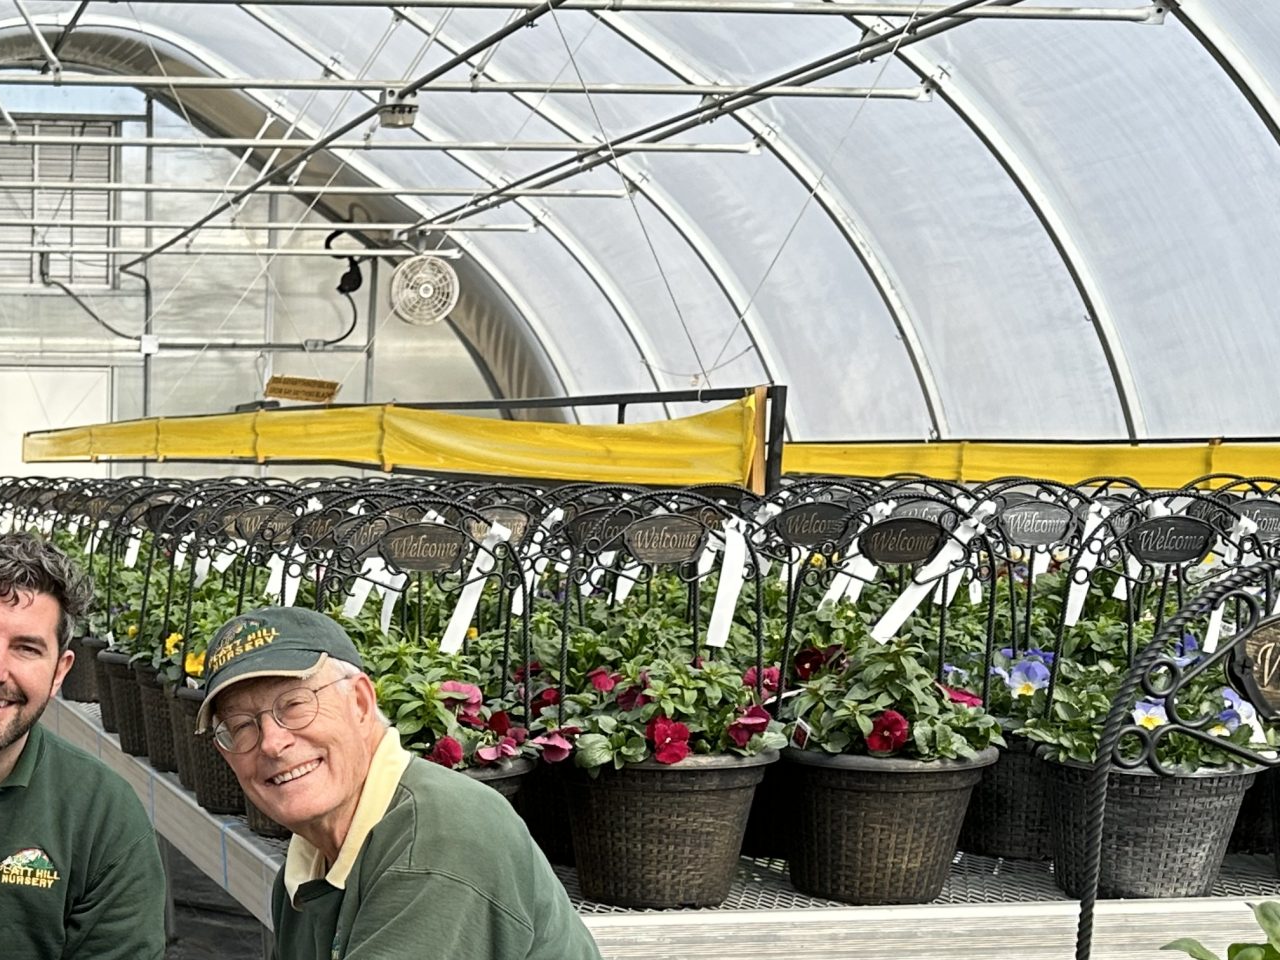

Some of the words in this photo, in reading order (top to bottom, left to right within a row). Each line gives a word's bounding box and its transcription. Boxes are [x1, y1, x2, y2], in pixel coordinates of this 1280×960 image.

[391, 534, 458, 558] Welcome
[634, 526, 697, 549] Welcome
[871, 528, 936, 551] Welcome
[1138, 526, 1205, 551] Welcome
[247, 627, 280, 641] HILL
[213, 636, 274, 672] NURSERY
[1, 874, 54, 888] NURSERY
[35, 868, 60, 880] HILL
